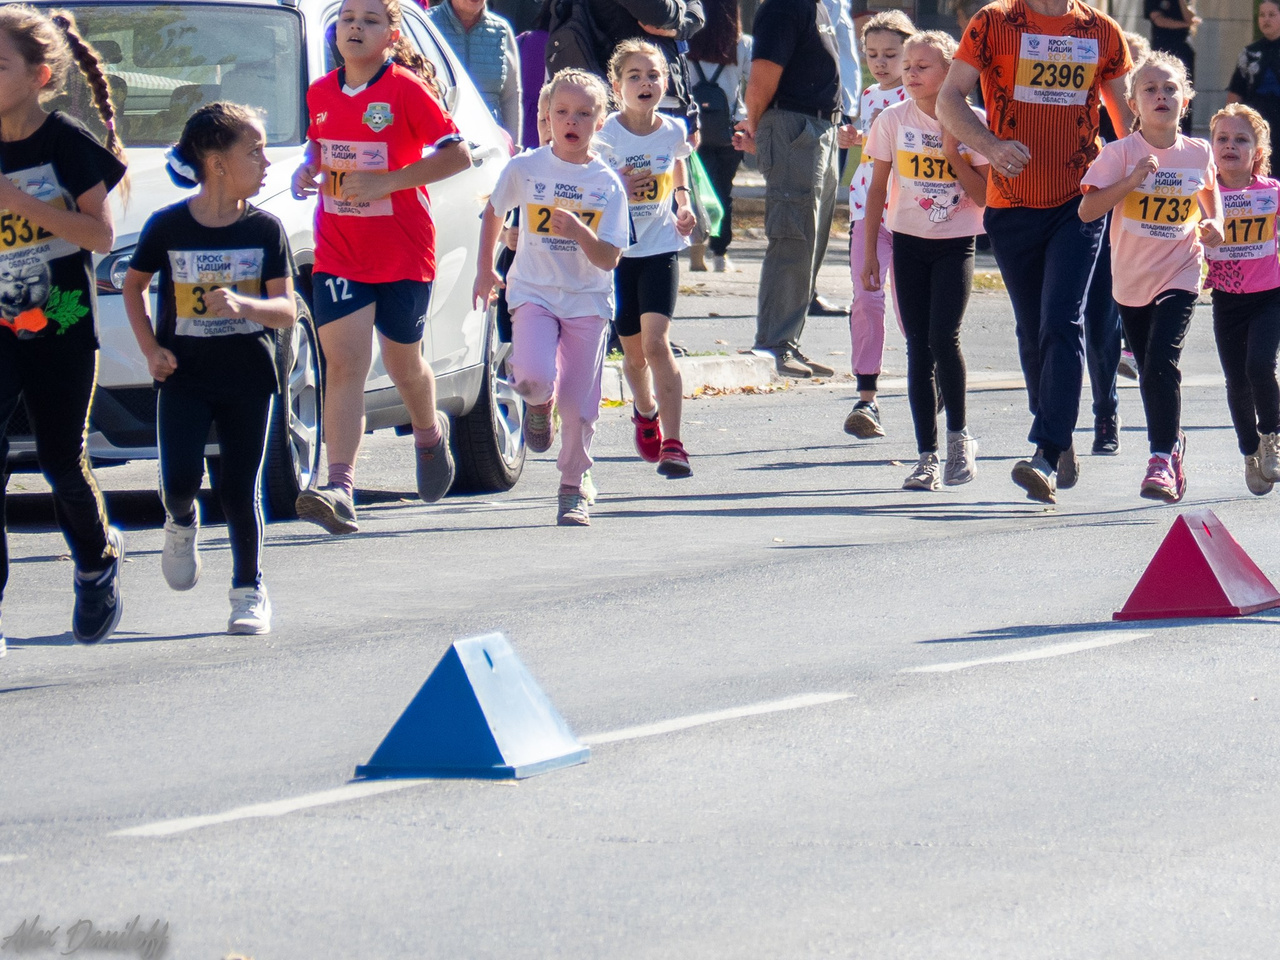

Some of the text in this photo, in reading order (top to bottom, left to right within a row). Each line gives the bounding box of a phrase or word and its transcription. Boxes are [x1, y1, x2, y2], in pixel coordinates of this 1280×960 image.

[1048, 53, 1073, 61] 2024
[1030, 62, 1085, 89] 2396
[331, 144, 350, 152] КРОСС
[923, 146, 943, 156] 202
[331, 152, 357, 160] НАЦИИ
[333, 160, 358, 170] 2024
[1155, 171, 1177, 179] КРОСС
[555, 183, 578, 192] КРОСС
[914, 180, 956, 189] ВЛАДИМИРСКАЯ
[1154, 179, 1182, 187] НАЦИИ
[922, 187, 948, 195] ОБЛАСТЬ
[1154, 186, 1182, 195] 2024
[554, 191, 583, 200] НАЦИИ
[1224, 193, 1245, 201] КРОСС
[554, 198, 582, 208] 2024
[1224, 200, 1252, 209] НАЦИИ
[1139, 196, 1192, 222] 1733
[1226, 208, 1253, 217] 2024
[1149, 230, 1177, 239] ОБЛАСТЬ
[550, 244, 577, 252] ОБЛАСТЬ
[1220, 244, 1263, 253] ВЛАДИМИРСКАЯ
[196, 255, 223, 263] КРОСС
[1228, 251, 1255, 259] ОБЛАСТЬ
[197, 263, 231, 272] НАЦИИ
[325, 276, 353, 303] 12
[193, 318, 246, 326] ВЛАДИМИРСКАЯ
[204, 326, 236, 335] ОБЛАСТЬ
